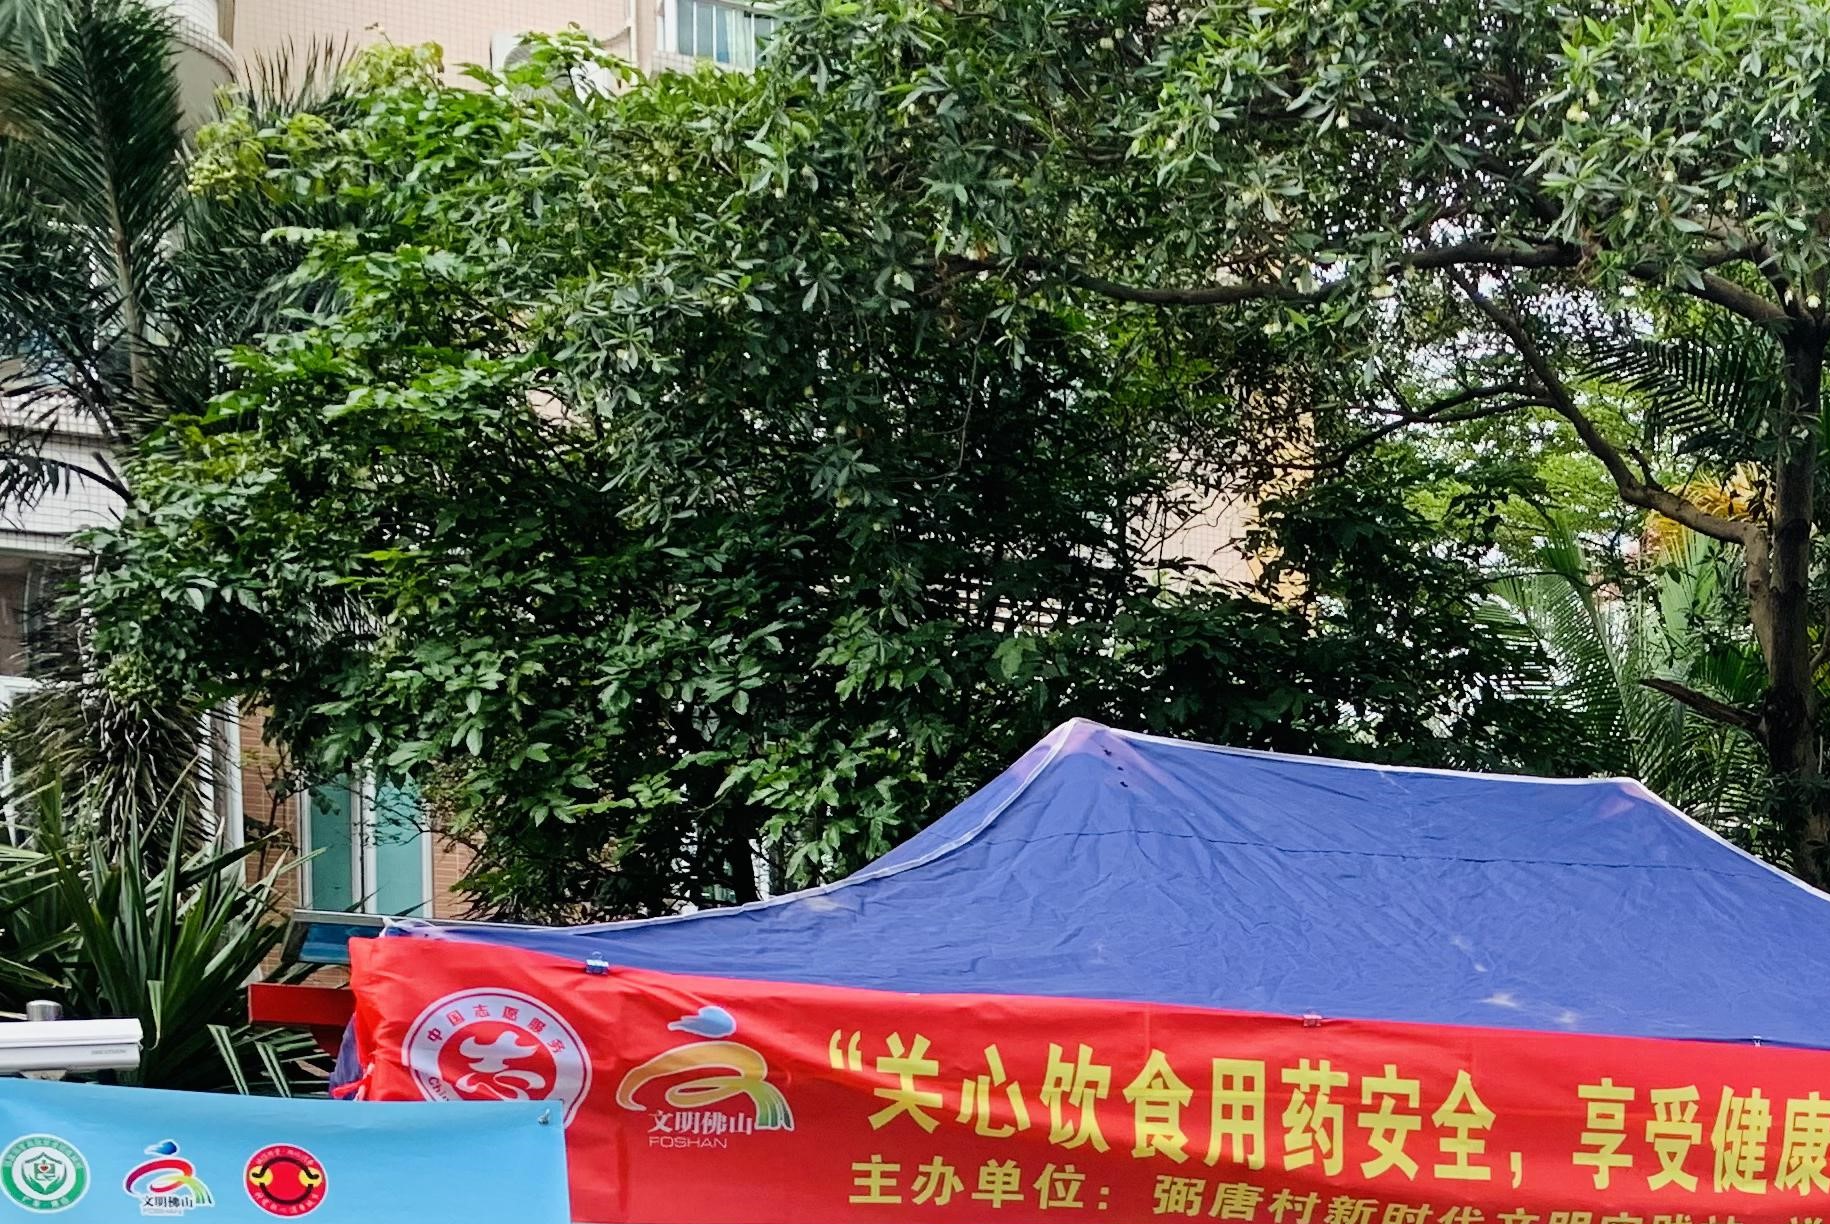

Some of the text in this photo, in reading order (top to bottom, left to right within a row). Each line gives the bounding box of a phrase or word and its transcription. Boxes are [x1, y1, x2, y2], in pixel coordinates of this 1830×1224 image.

[427, 1003, 567, 1054] 中国志愿服务
[648, 1110, 755, 1136] 文明佛山
[648, 1137, 728, 1149] FOSHAN
